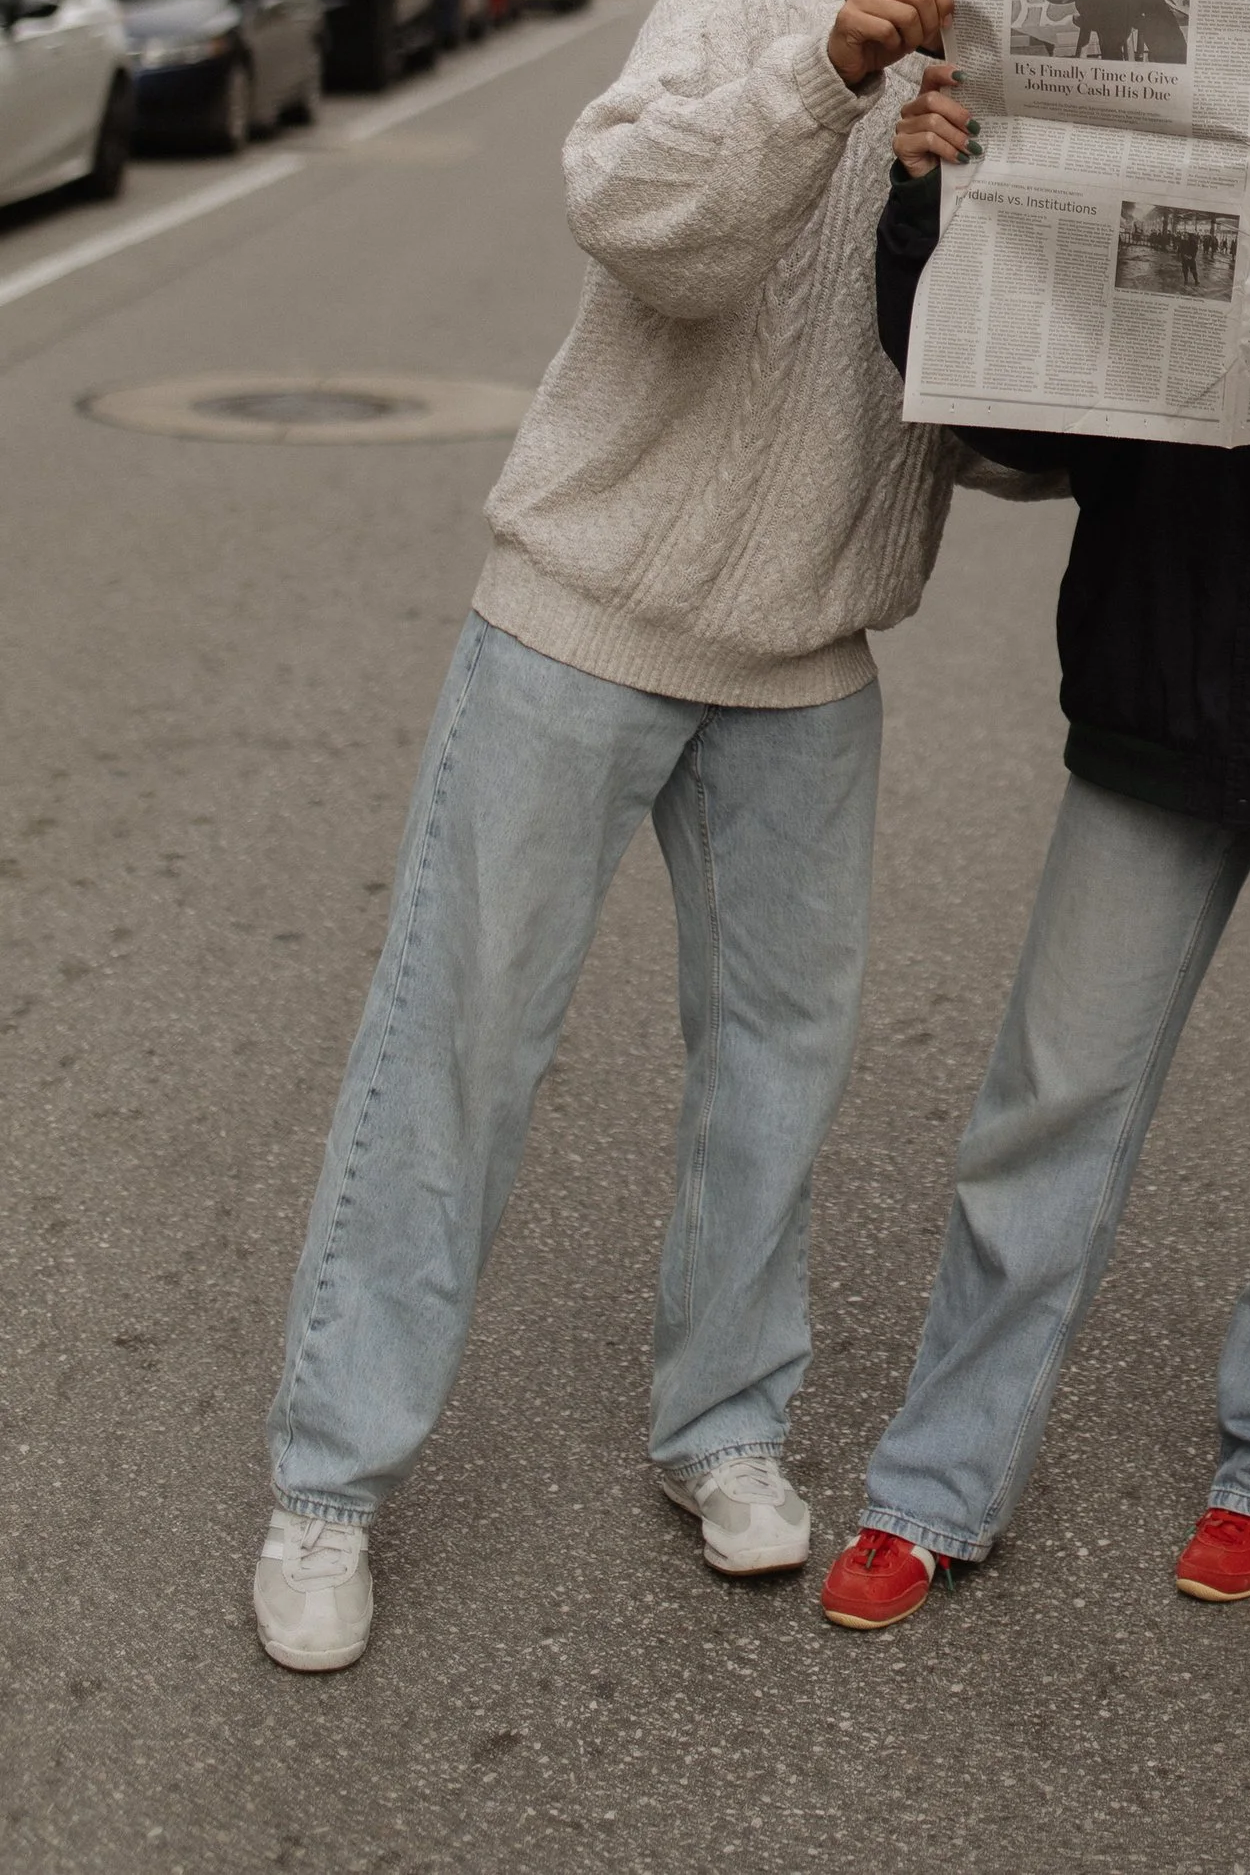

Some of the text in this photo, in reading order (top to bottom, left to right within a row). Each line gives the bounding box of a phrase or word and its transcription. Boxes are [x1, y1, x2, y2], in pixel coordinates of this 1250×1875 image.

[1040, 64, 1087, 82] Finally
[1091, 67, 1127, 81] Time
[1130, 71, 1143, 83] to
[1148, 71, 1179, 85] Give
[1025, 78, 1171, 101] Johnny Cash His Due
[1008, 195, 1023, 206] vs.
[1027, 196, 1097, 215] Institutions
